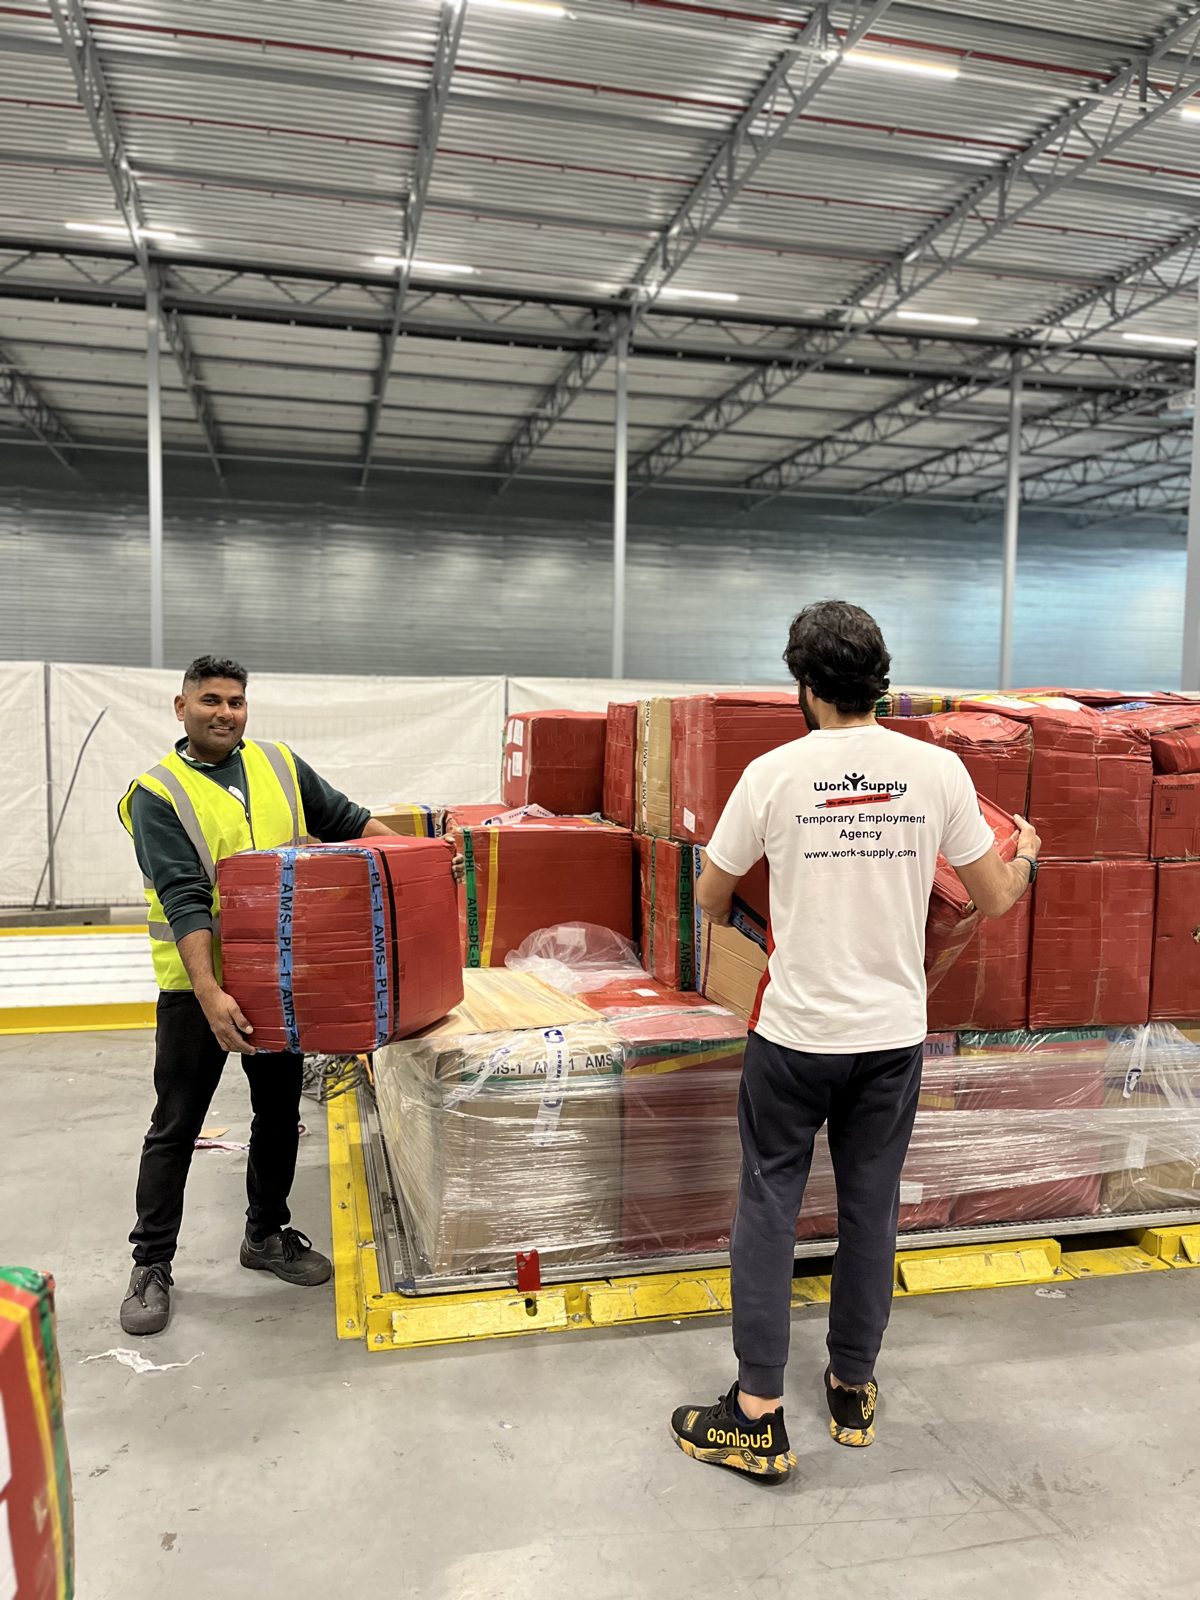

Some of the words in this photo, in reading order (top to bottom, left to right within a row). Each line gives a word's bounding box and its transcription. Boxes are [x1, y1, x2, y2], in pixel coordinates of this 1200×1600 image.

[795, 814, 855, 825] Temporary
[858, 813, 926, 824] Employment
[839, 829, 882, 841] Agency
[804, 848, 917, 859] www.work-supply.com
[279, 882, 294, 977] AMS-PL-1
[373, 924, 388, 1019] AMS-PL-1
